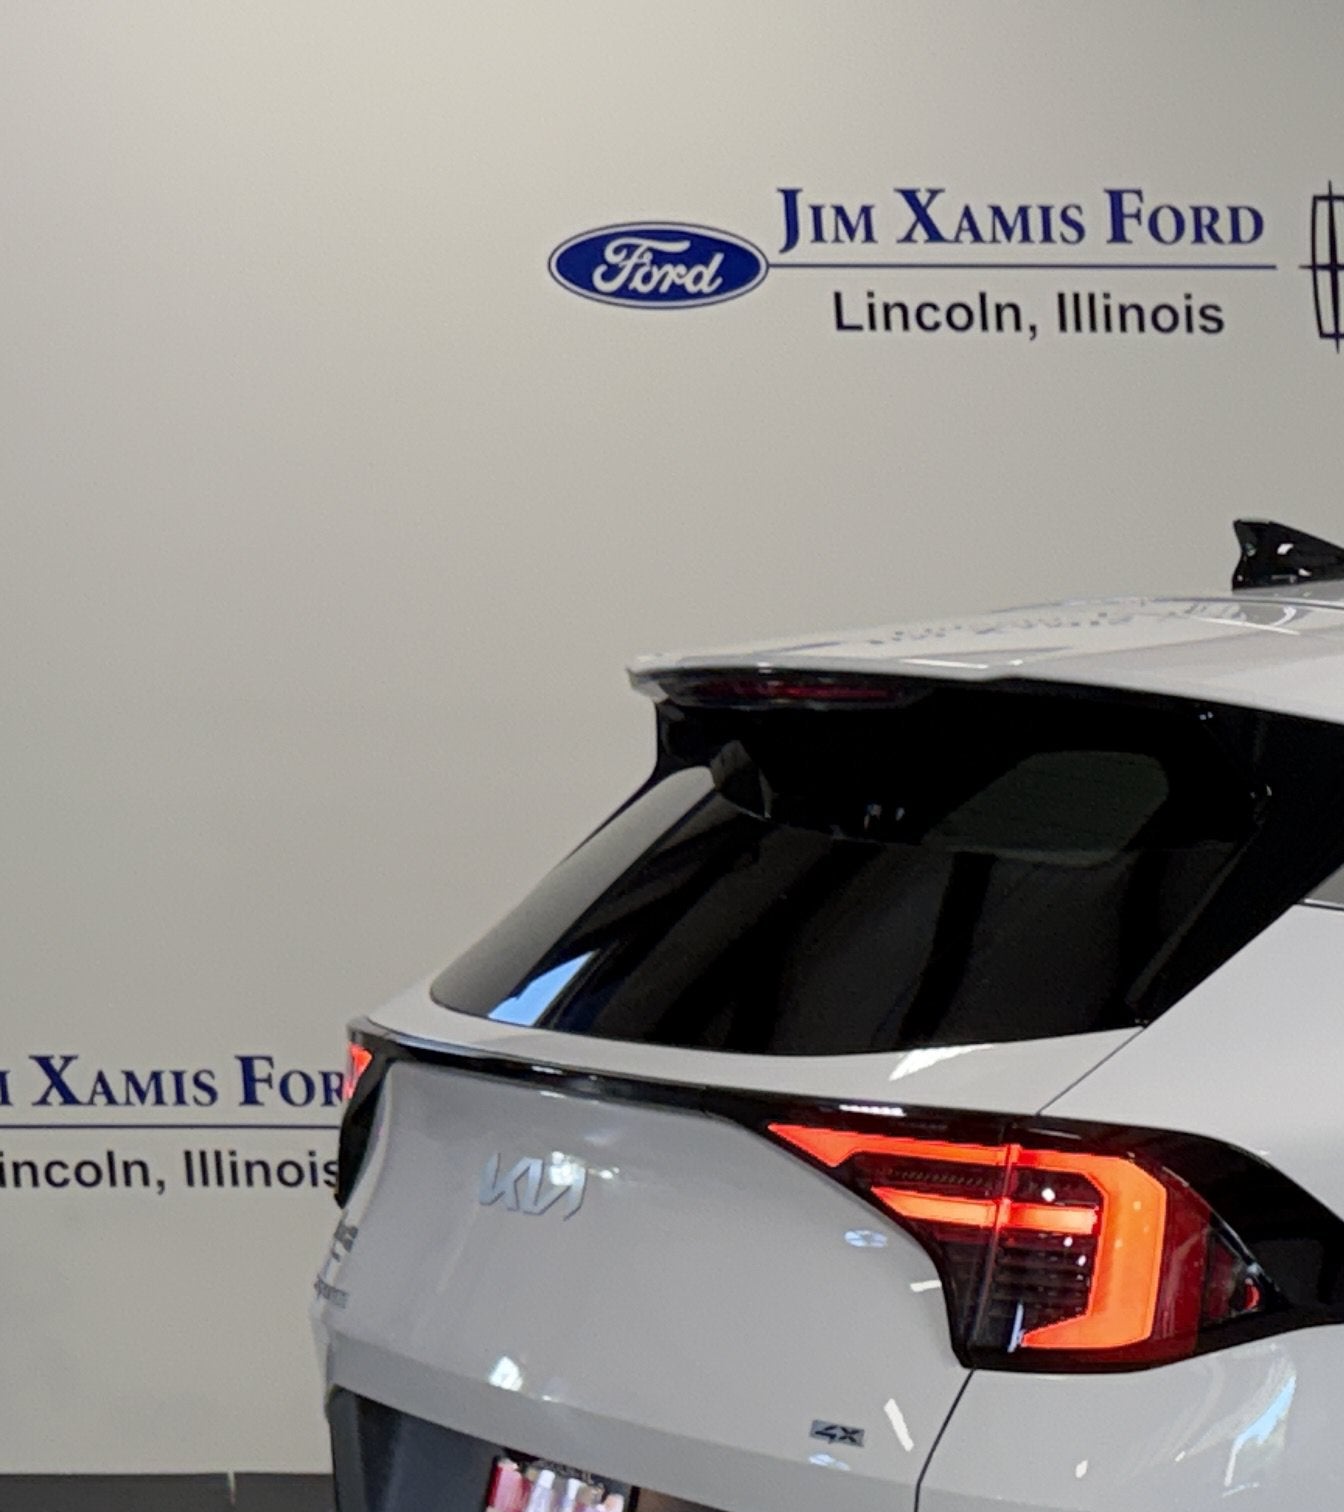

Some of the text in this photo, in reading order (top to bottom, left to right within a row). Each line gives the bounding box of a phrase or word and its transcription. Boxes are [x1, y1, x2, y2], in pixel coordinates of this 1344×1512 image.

[777, 188, 1264, 254] JIM XAMIS FORD
[595, 236, 724, 295] Ford
[834, 291, 1225, 340] Lincoln, Illinois
[29, 1054, 218, 1107] XAMIS
[234, 1055, 344, 1107] FOR
[0, 1150, 165, 1195] incoln,
